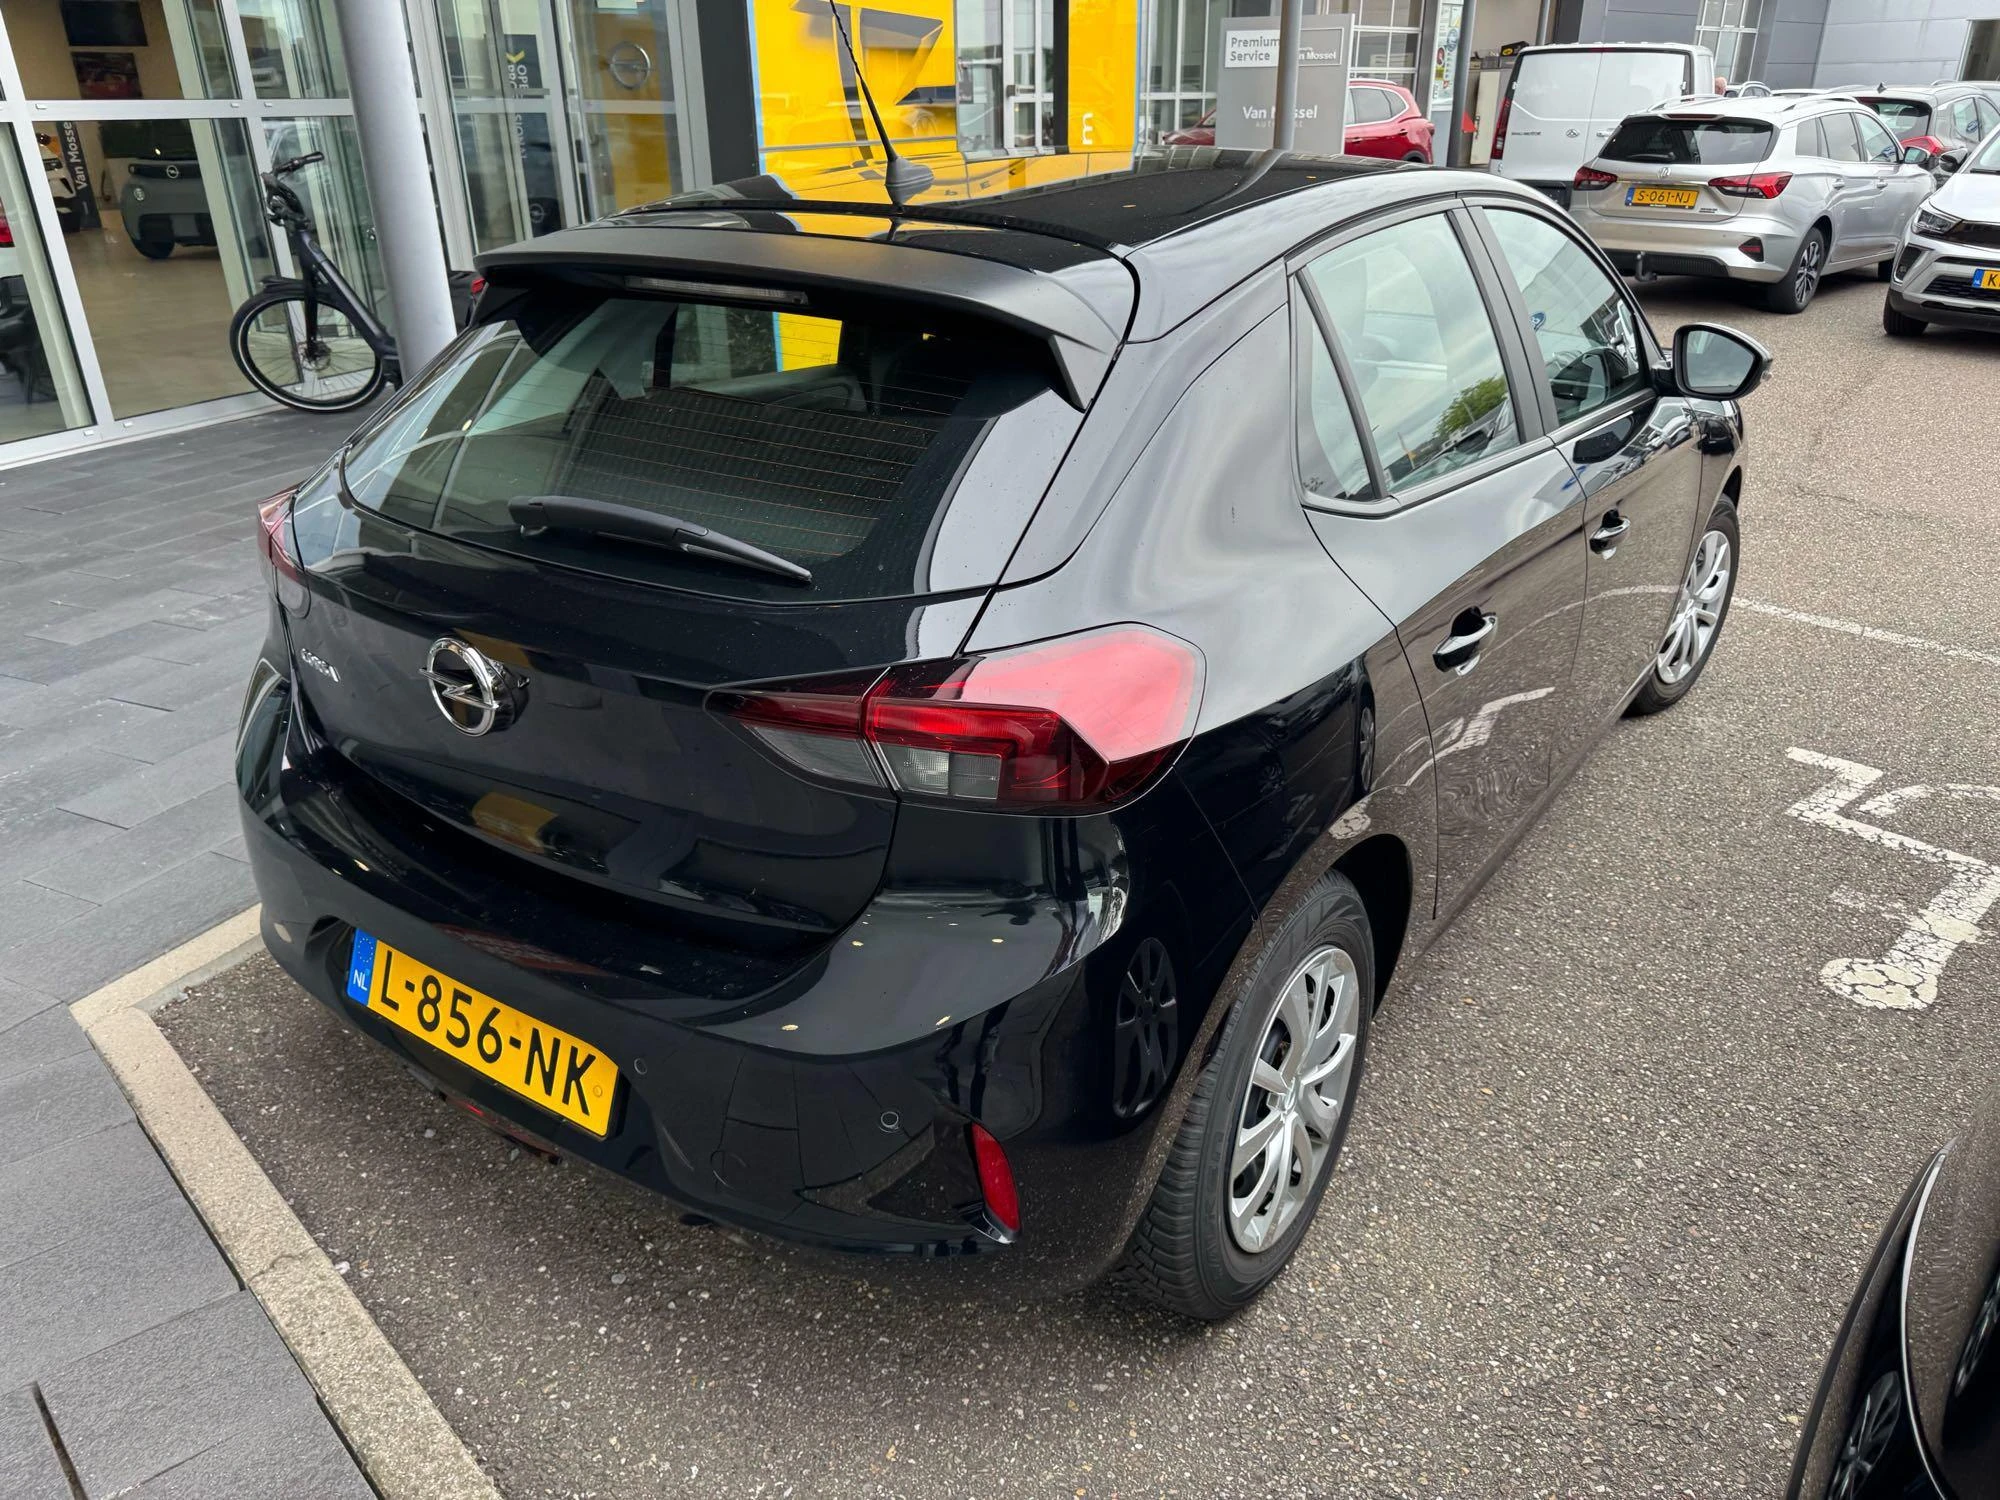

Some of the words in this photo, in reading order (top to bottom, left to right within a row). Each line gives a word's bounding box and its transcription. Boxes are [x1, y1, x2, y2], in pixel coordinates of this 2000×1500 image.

[1231, 36, 1280, 47] Premium
[1230, 50, 1270, 61] Service
[1306, 51, 1336, 60] Mossel
[516, 64, 529, 89] OPE
[1242, 105, 1267, 119] Van
[63, 121, 82, 163] Mosse
[74, 166, 88, 190] Van
[1637, 190, 1692, 204] S-061-NJ
[353, 969, 369, 991] NL
[380, 950, 597, 1117] L-856-NK
